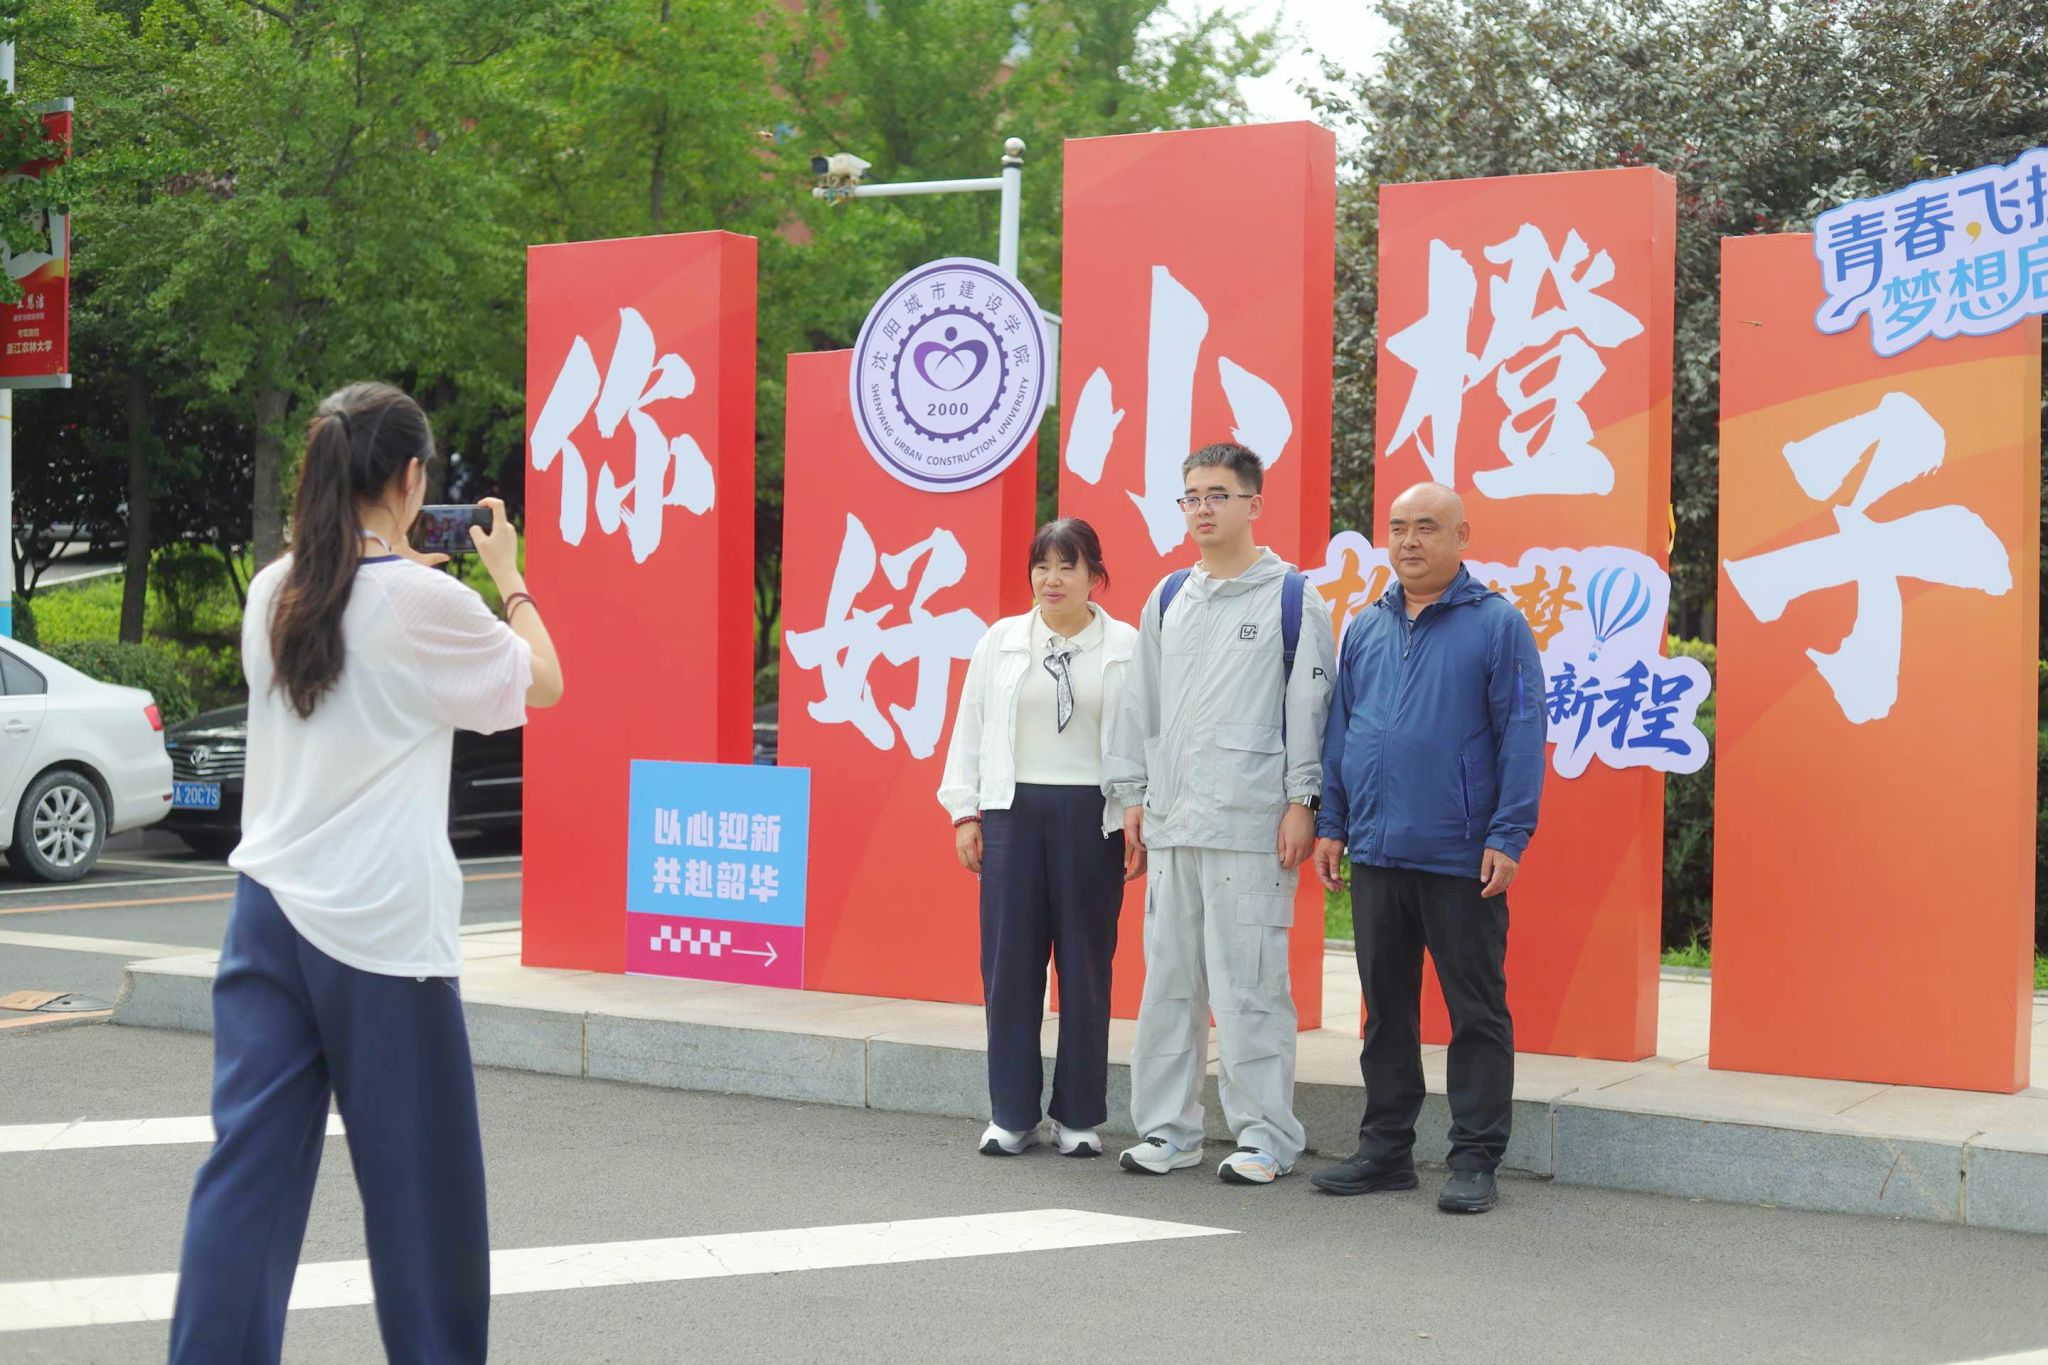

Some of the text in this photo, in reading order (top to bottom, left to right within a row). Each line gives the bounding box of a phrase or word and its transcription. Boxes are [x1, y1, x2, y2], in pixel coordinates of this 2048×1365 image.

[871, 280, 1030, 370] 沈阳城市建设学院
[871, 376, 1030, 466] SHENYANG URBAN CONSTRUCTION UNIVERSITY
[927, 402, 969, 416] 2000
[532, 223, 2012, 760] 你 好 小 橙 子
[654, 807, 782, 853] 以心迎新
[652, 856, 780, 903] 共赴韶华
